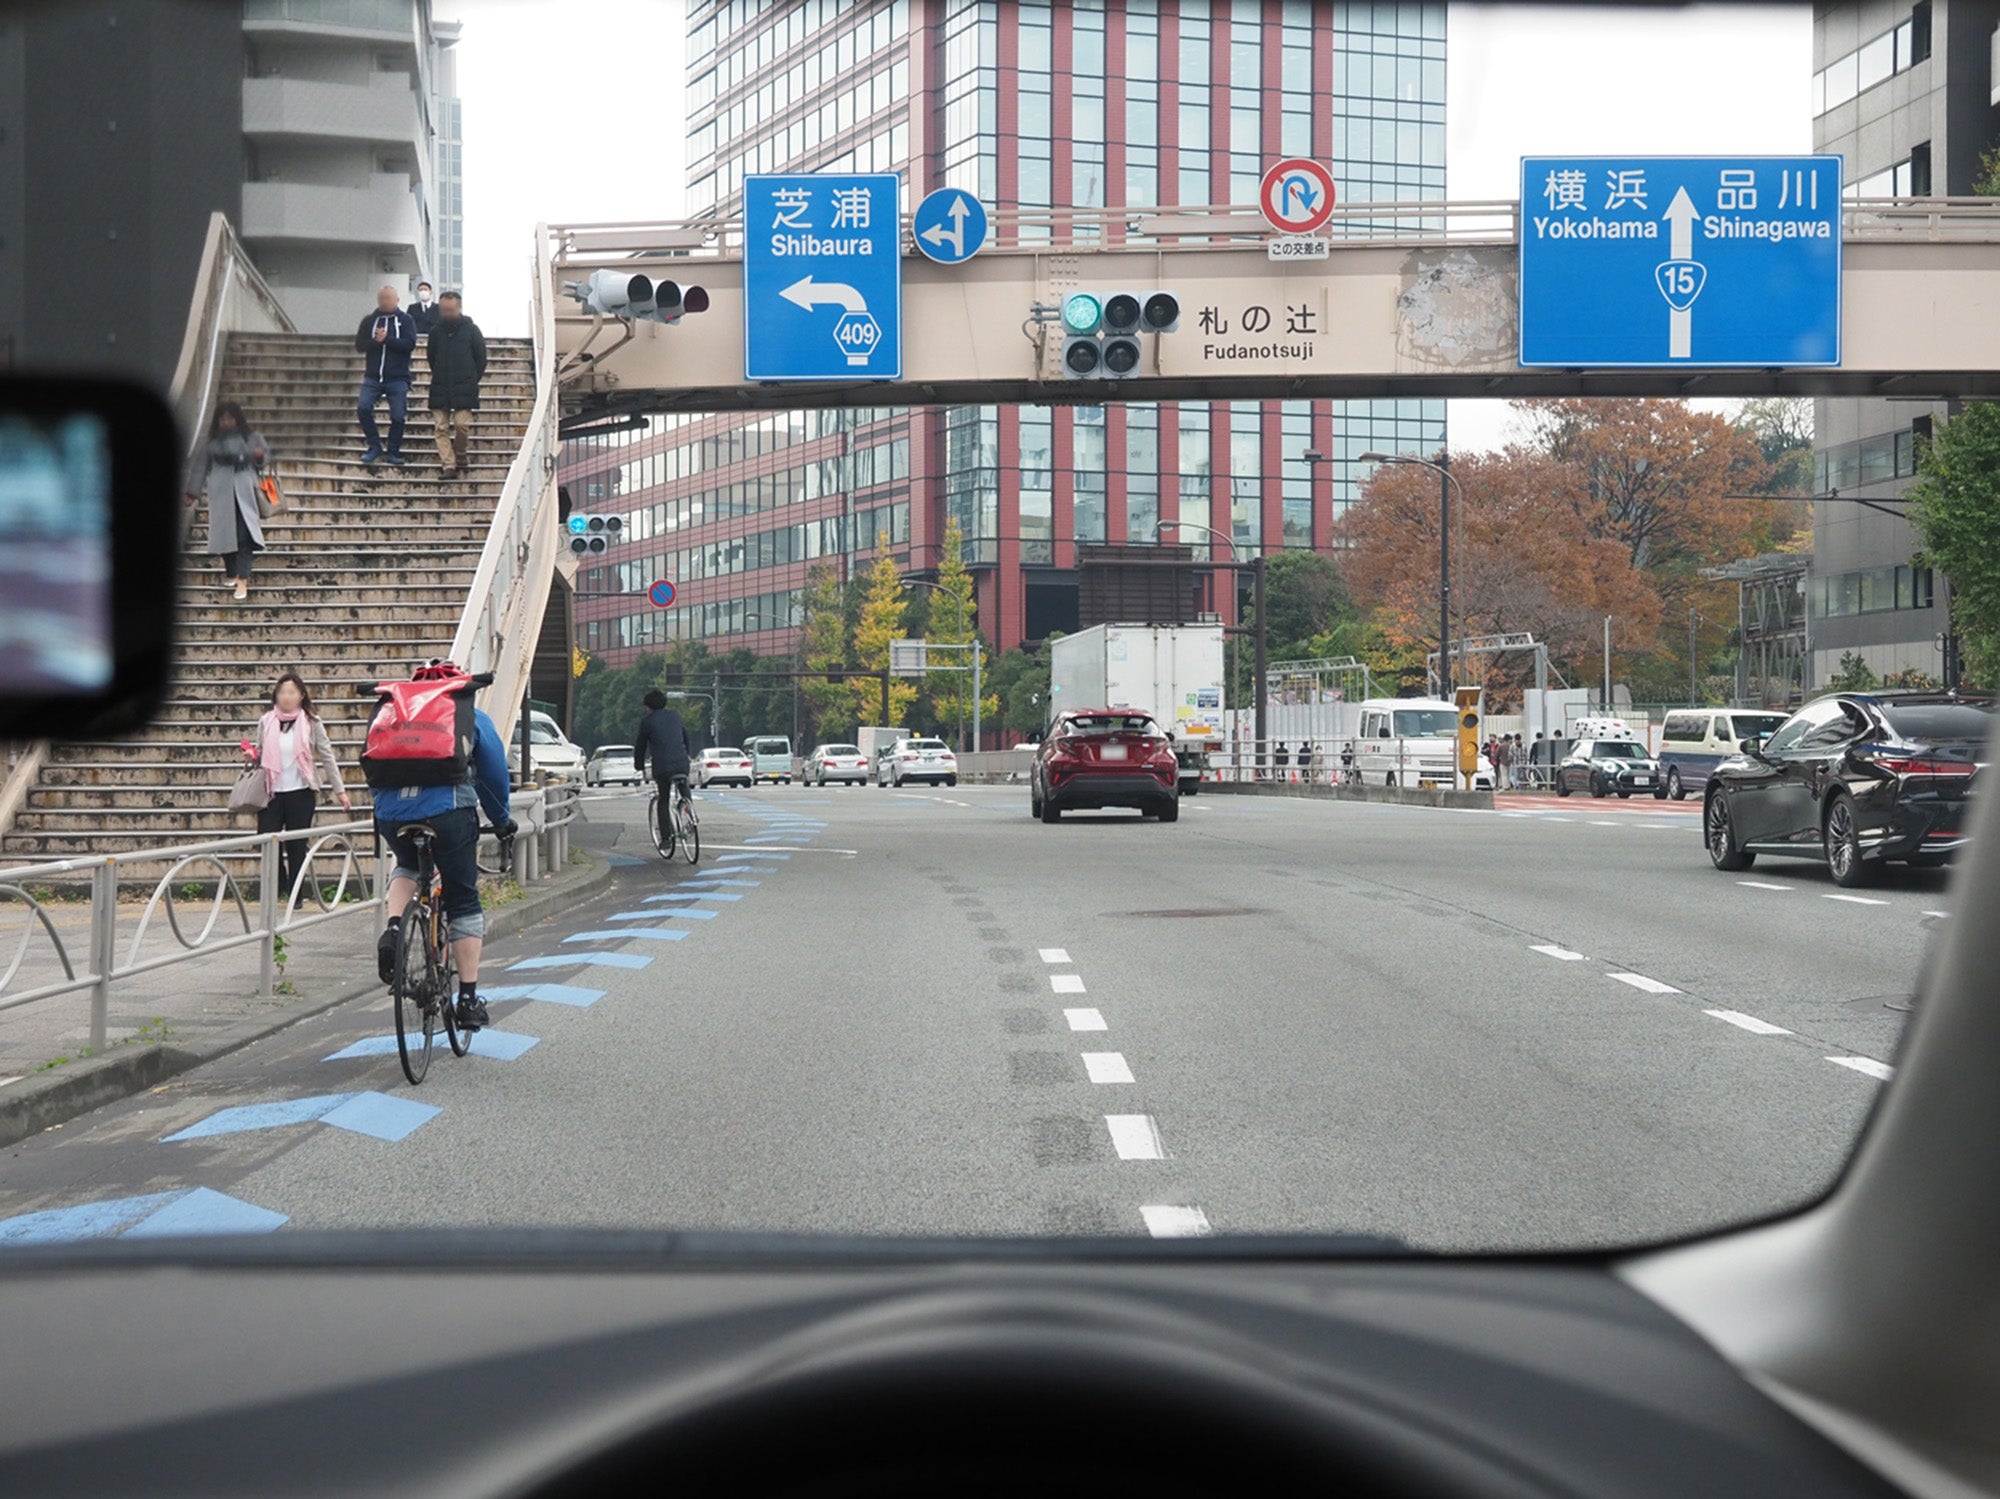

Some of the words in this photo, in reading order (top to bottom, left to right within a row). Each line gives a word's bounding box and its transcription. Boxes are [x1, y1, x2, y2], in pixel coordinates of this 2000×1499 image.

[1543, 169, 1648, 211] 横浜
[1717, 169, 1817, 210] 品川
[772, 187, 871, 229] 芝浦
[1533, 216, 1658, 239] Yokohama
[1703, 215, 1830, 243] Shinagawa
[771, 234, 873, 256] Shibaura
[1272, 241, 1325, 256] この交差点
[1664, 266, 1694, 294] 15
[1198, 303, 1317, 335] 札の辻
[840, 323, 875, 345] 409
[1204, 342, 1314, 361] Fudanotsuji
